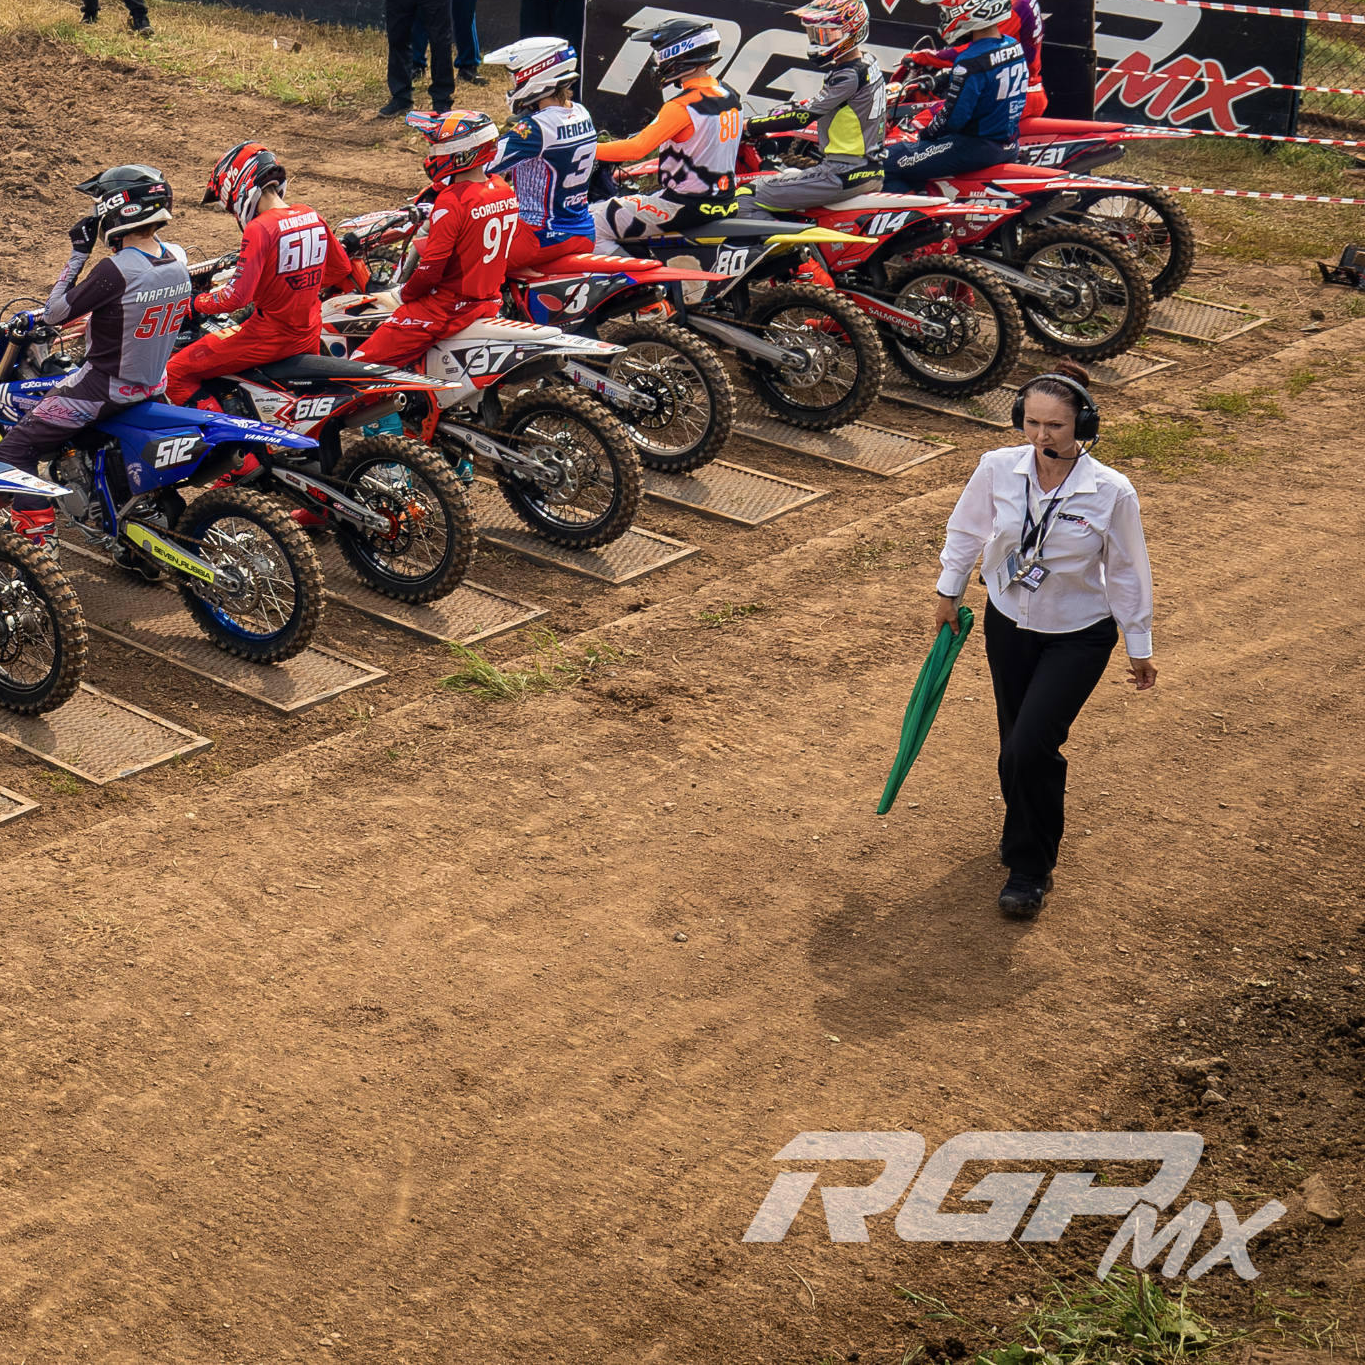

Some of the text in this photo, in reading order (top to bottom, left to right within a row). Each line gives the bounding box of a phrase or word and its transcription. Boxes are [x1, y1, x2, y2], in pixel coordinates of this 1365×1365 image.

[658, 39, 695, 61] 100%
[515, 57, 557, 82] LUCID
[719, 108, 740, 143] 80
[562, 147, 595, 187] 3
[1028, 147, 1067, 167] 331
[219, 165, 240, 206] 100%
[97, 194, 125, 214] EKS
[278, 212, 320, 232] KLIUSHKIN
[868, 210, 910, 235] 114
[277, 226, 328, 276] 616
[482, 212, 518, 265] 97
[715, 249, 750, 276] 80
[565, 284, 590, 312] 3
[135, 301, 190, 340] 512
[868, 306, 919, 331] SALMONICA
[465, 345, 515, 375] 97
[243, 433, 282, 445] YAMAHA
[154, 436, 201, 470] 512
